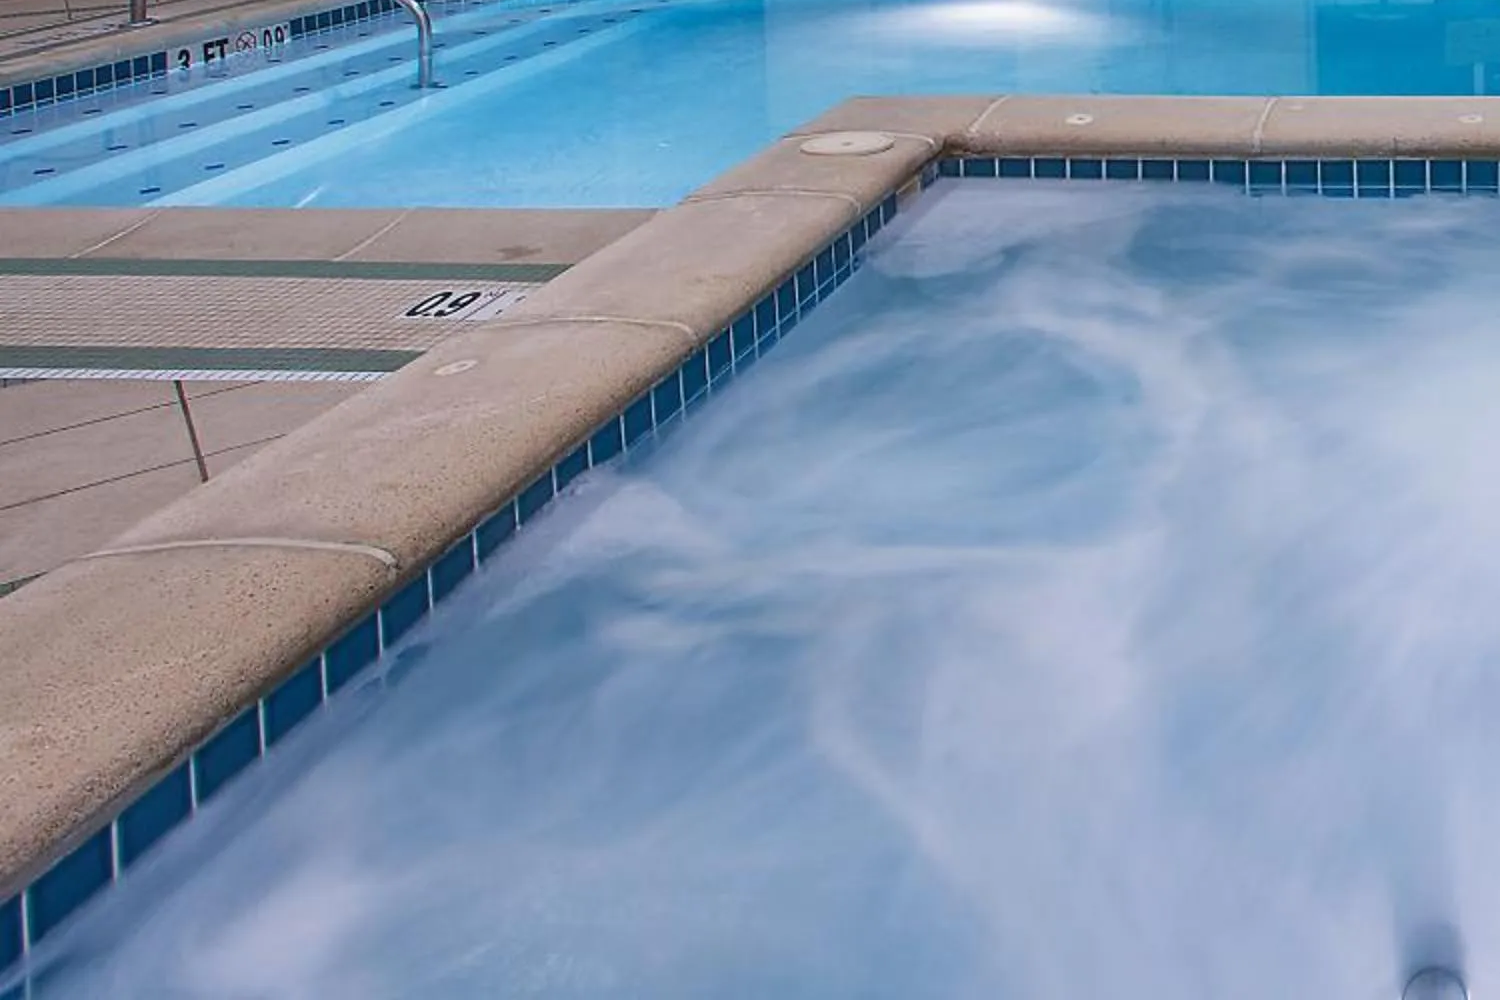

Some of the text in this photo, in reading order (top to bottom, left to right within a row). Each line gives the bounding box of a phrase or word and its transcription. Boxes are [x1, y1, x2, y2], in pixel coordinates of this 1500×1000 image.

[178, 48, 191, 69] 3
[203, 37, 229, 63] FT
[405, 291, 482, 317] 0.9
